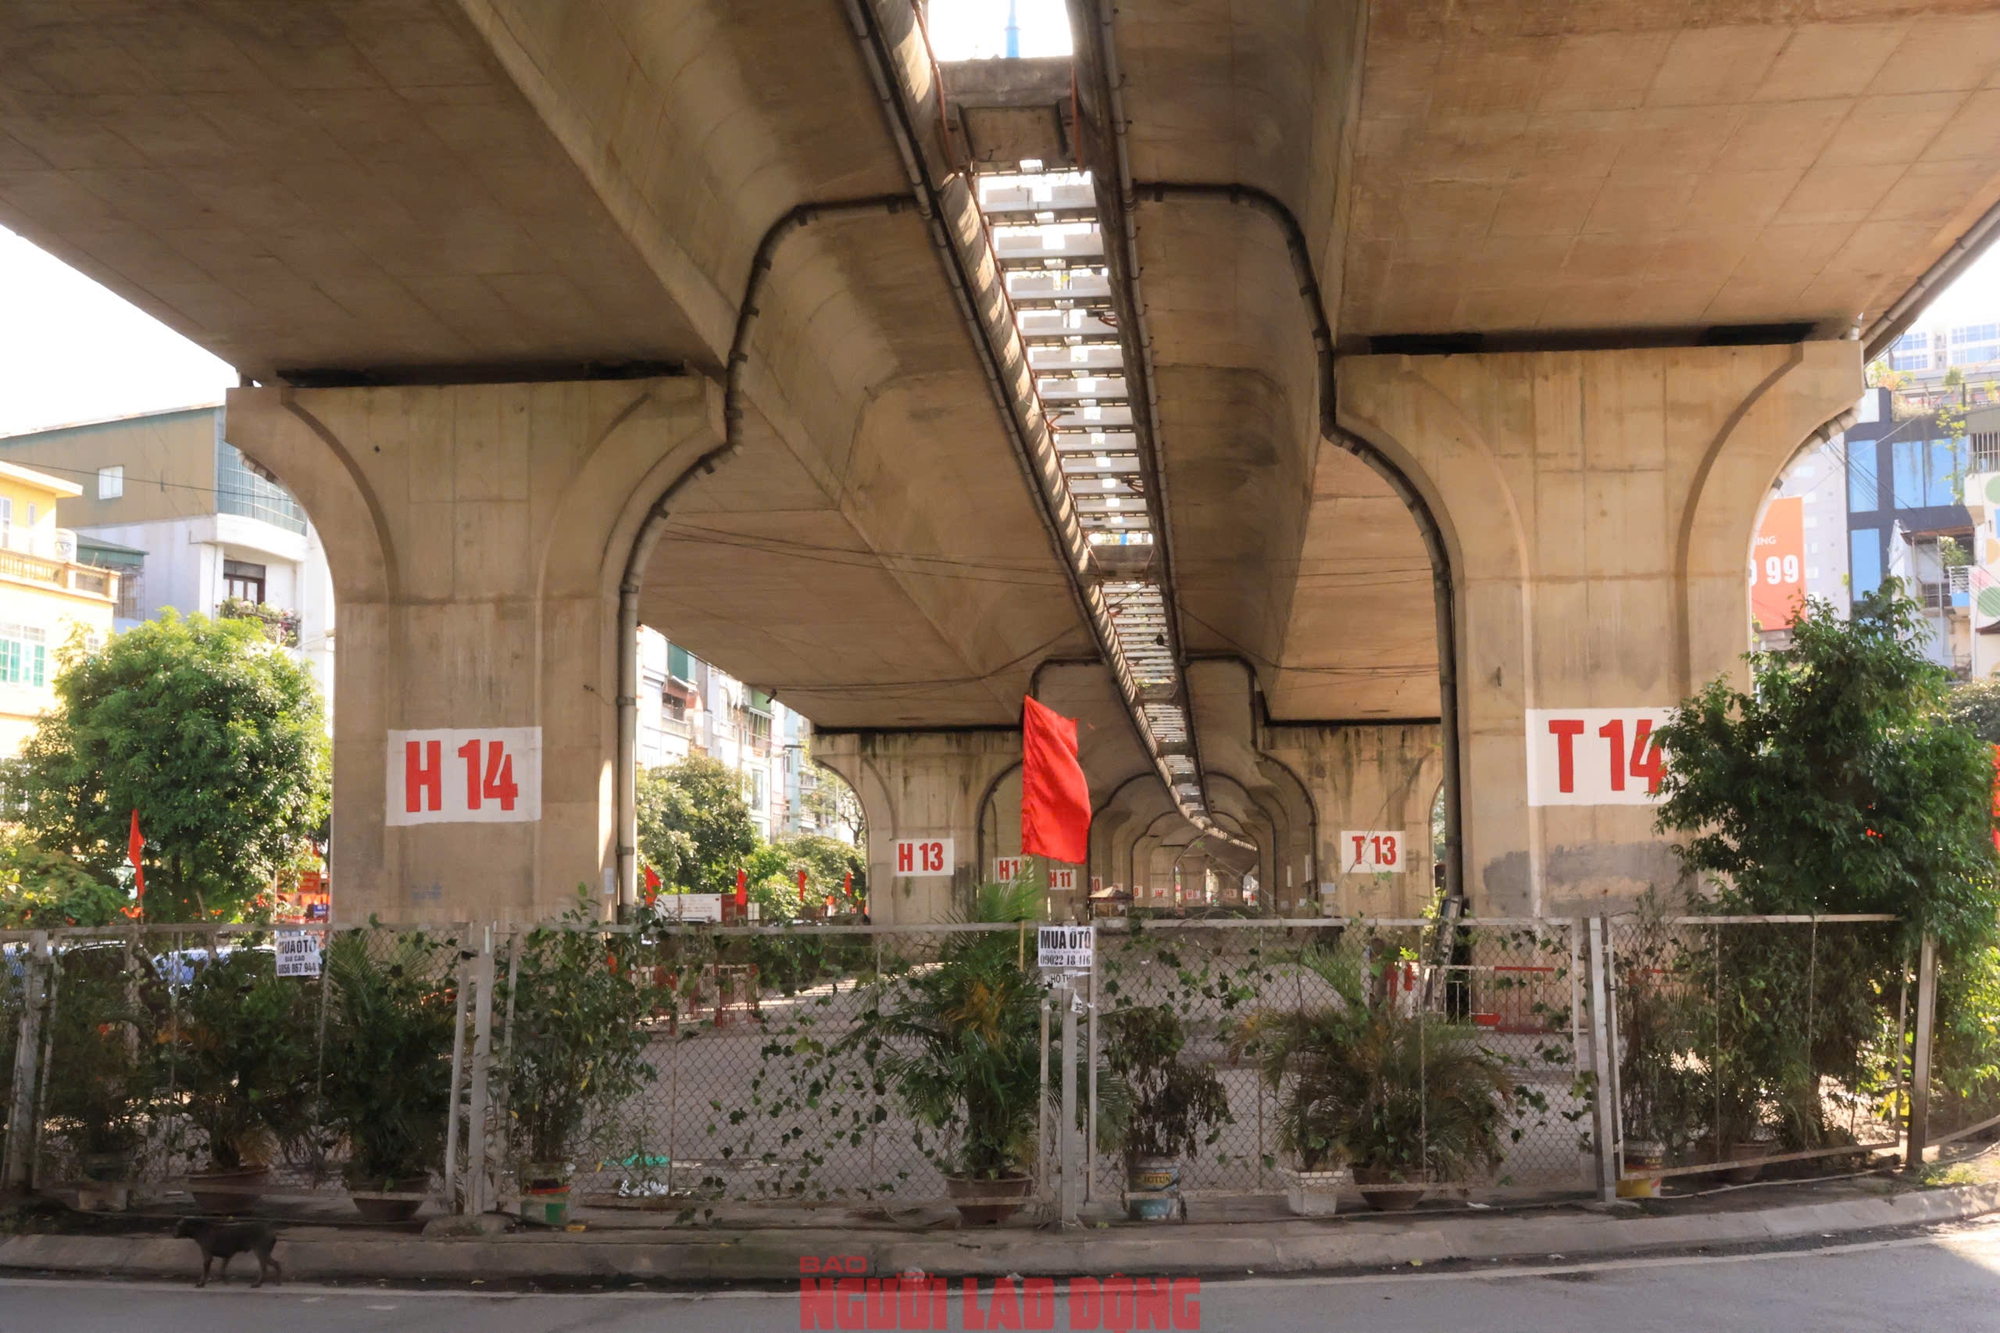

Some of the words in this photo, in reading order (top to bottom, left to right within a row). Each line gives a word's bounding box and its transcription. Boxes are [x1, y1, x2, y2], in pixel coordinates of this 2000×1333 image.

[1757, 536, 1776, 545] ING
[1549, 720, 1584, 793] T
[1599, 719, 1667, 794] 14
[406, 740, 441, 812] H
[458, 739, 518, 811] 14
[899, 843, 913, 872] H
[919, 842, 943, 871] 13
[1352, 836, 1365, 864] T
[1371, 836, 1396, 865] 13
[1000, 861, 1010, 880] H
[1049, 871, 1057, 887] H
[1060, 872, 1071, 887] 11
[1093, 878, 1100, 892] 0
[1040, 930, 1066, 949] MUA
[1069, 927, 1091, 949] ÔTÔ
[1040, 955, 1064, 965] 09022
[1067, 955, 1076, 965] 18
